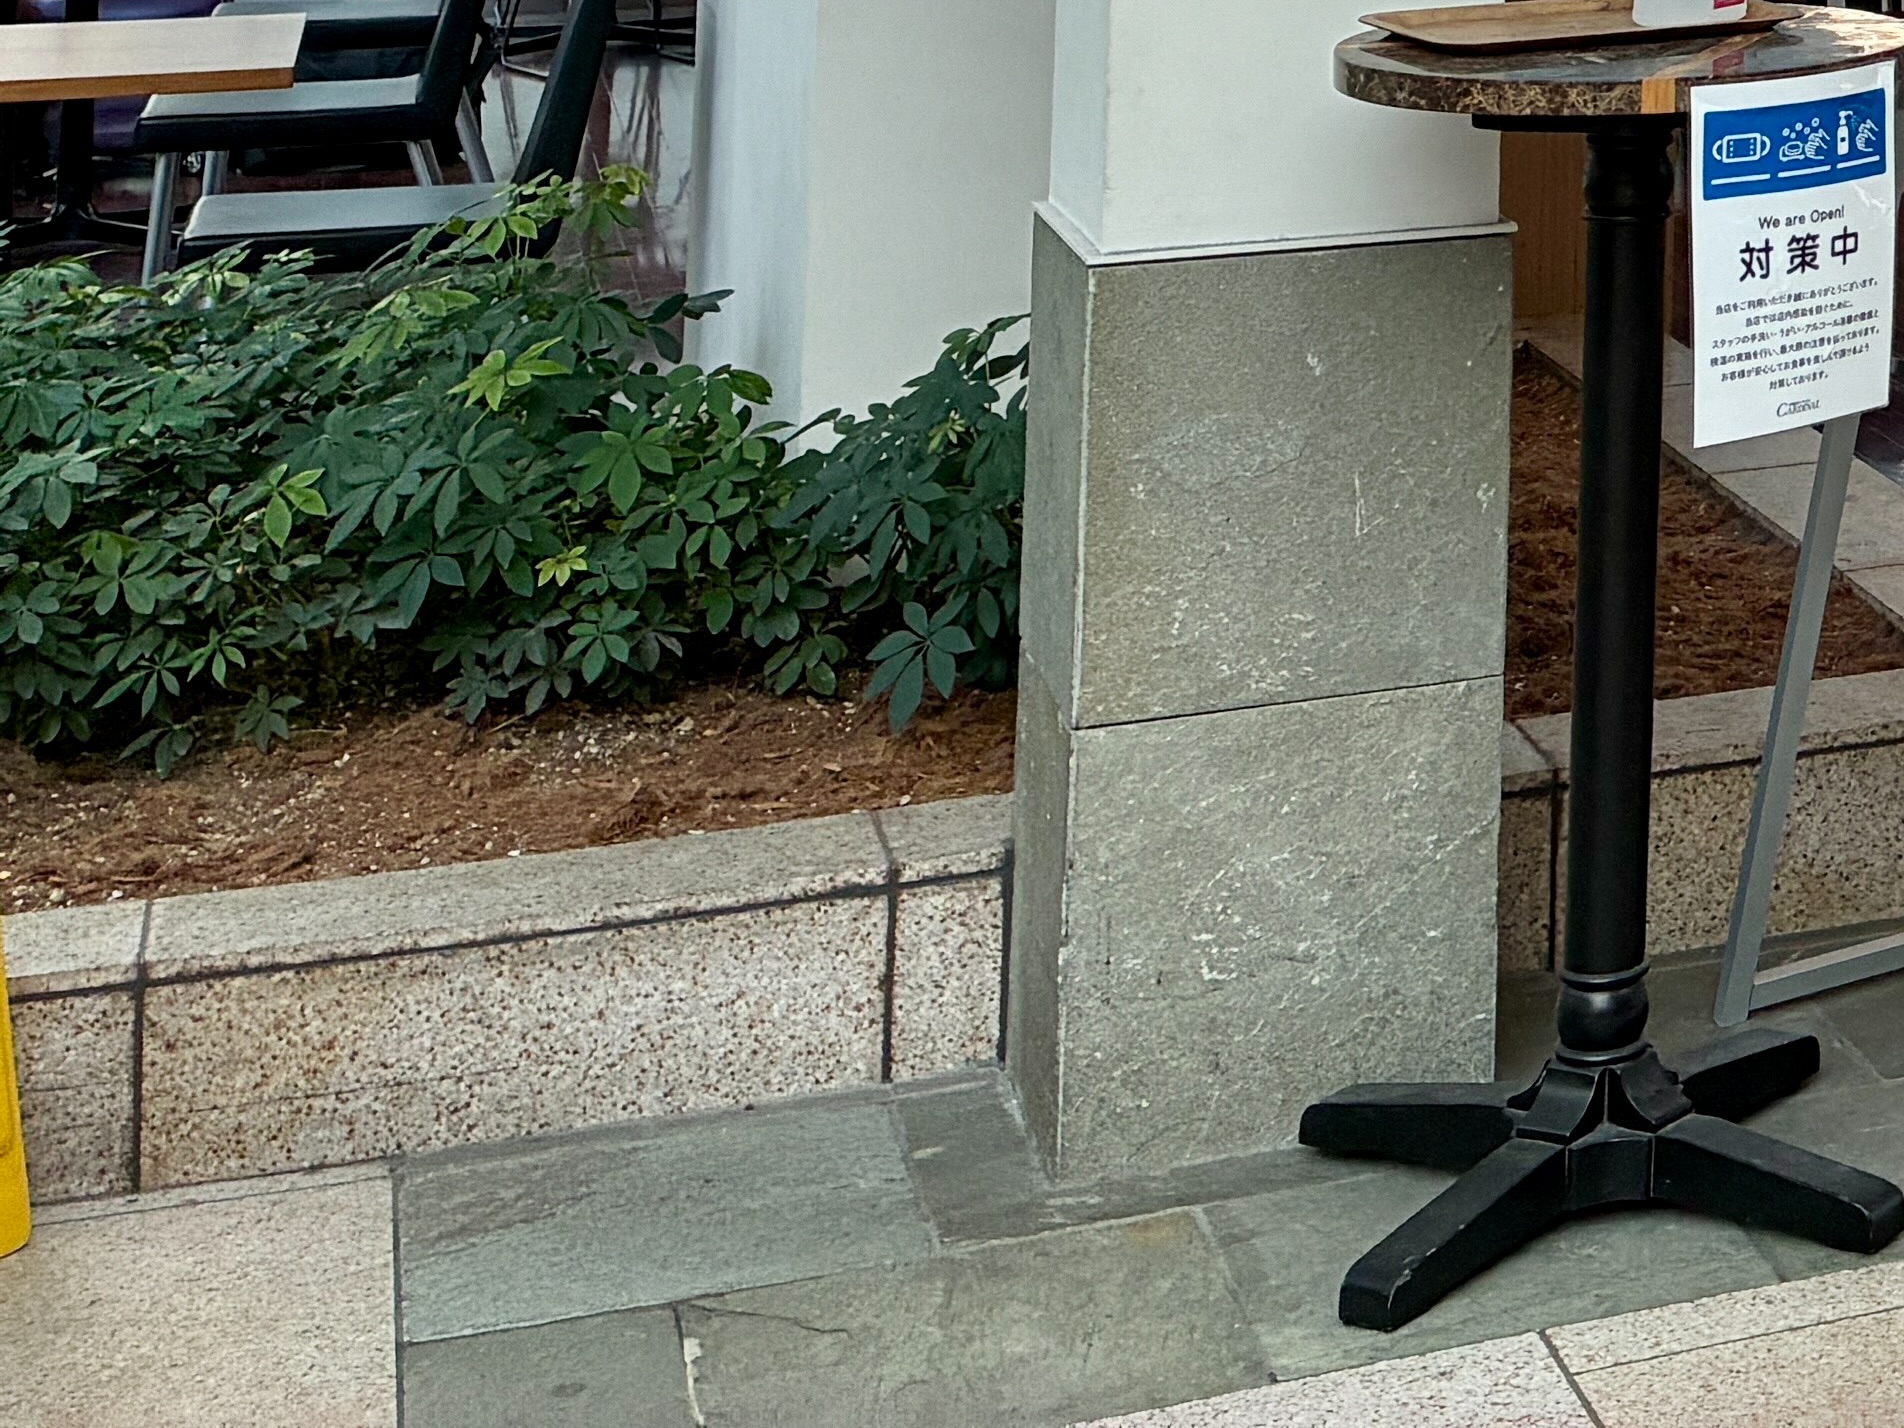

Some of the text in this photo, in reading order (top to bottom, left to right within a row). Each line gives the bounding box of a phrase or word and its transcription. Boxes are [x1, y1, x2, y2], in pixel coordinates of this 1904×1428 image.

[1758, 204, 1845, 230] We are Open!
[1739, 225, 1859, 283] 対策中
